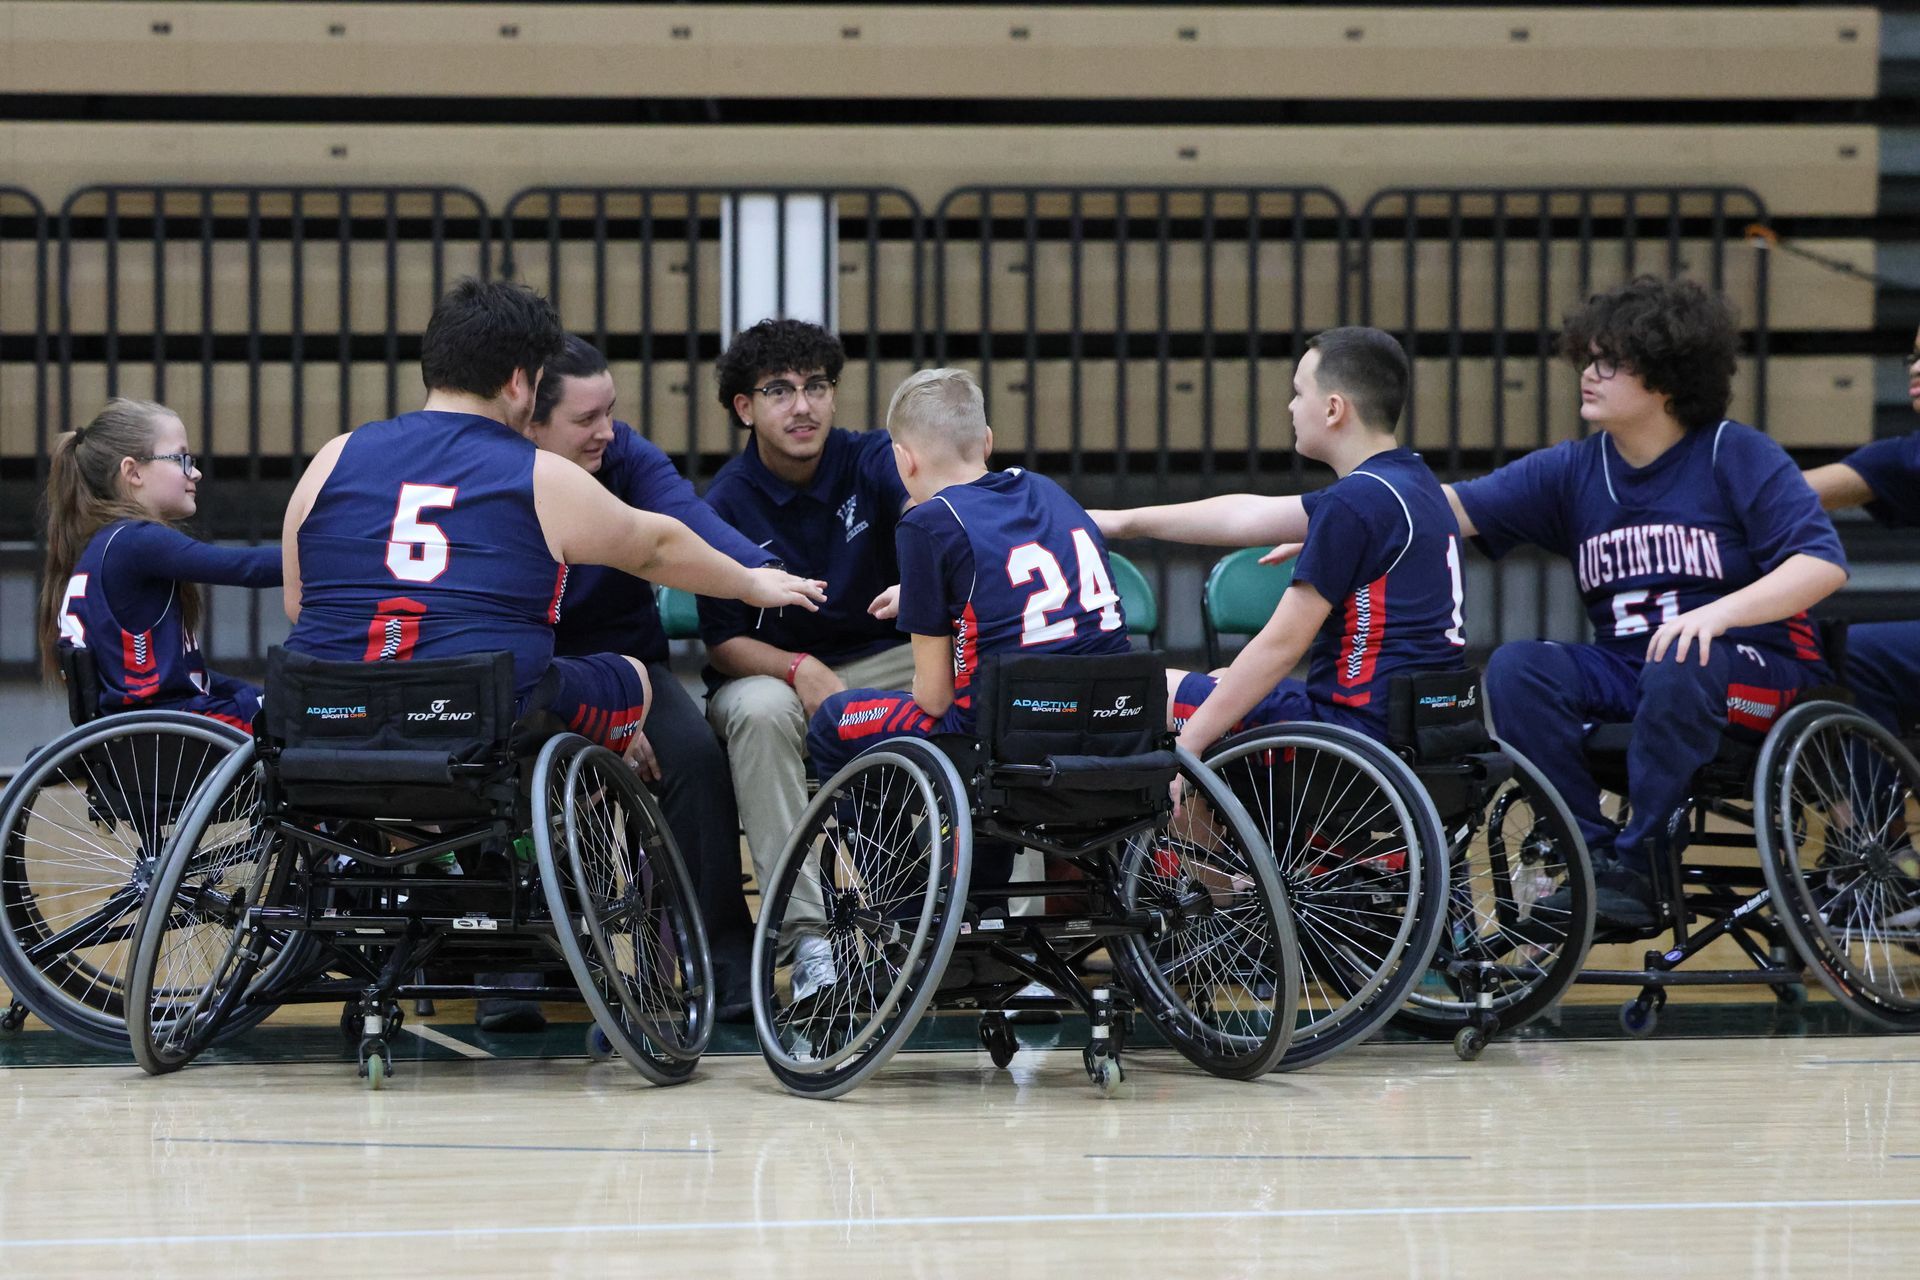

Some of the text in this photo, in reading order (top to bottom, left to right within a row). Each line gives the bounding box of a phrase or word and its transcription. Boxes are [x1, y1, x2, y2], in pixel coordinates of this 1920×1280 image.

[384, 481, 459, 584] 5
[1578, 524, 1723, 593] AUSTINTOWN
[1005, 528, 1122, 647] 24
[1012, 699, 1078, 709] ADAPTIVE
[306, 705, 367, 715] ADAPTIVE
[1092, 709, 1119, 718] TOP
[407, 712, 436, 721] TOP
